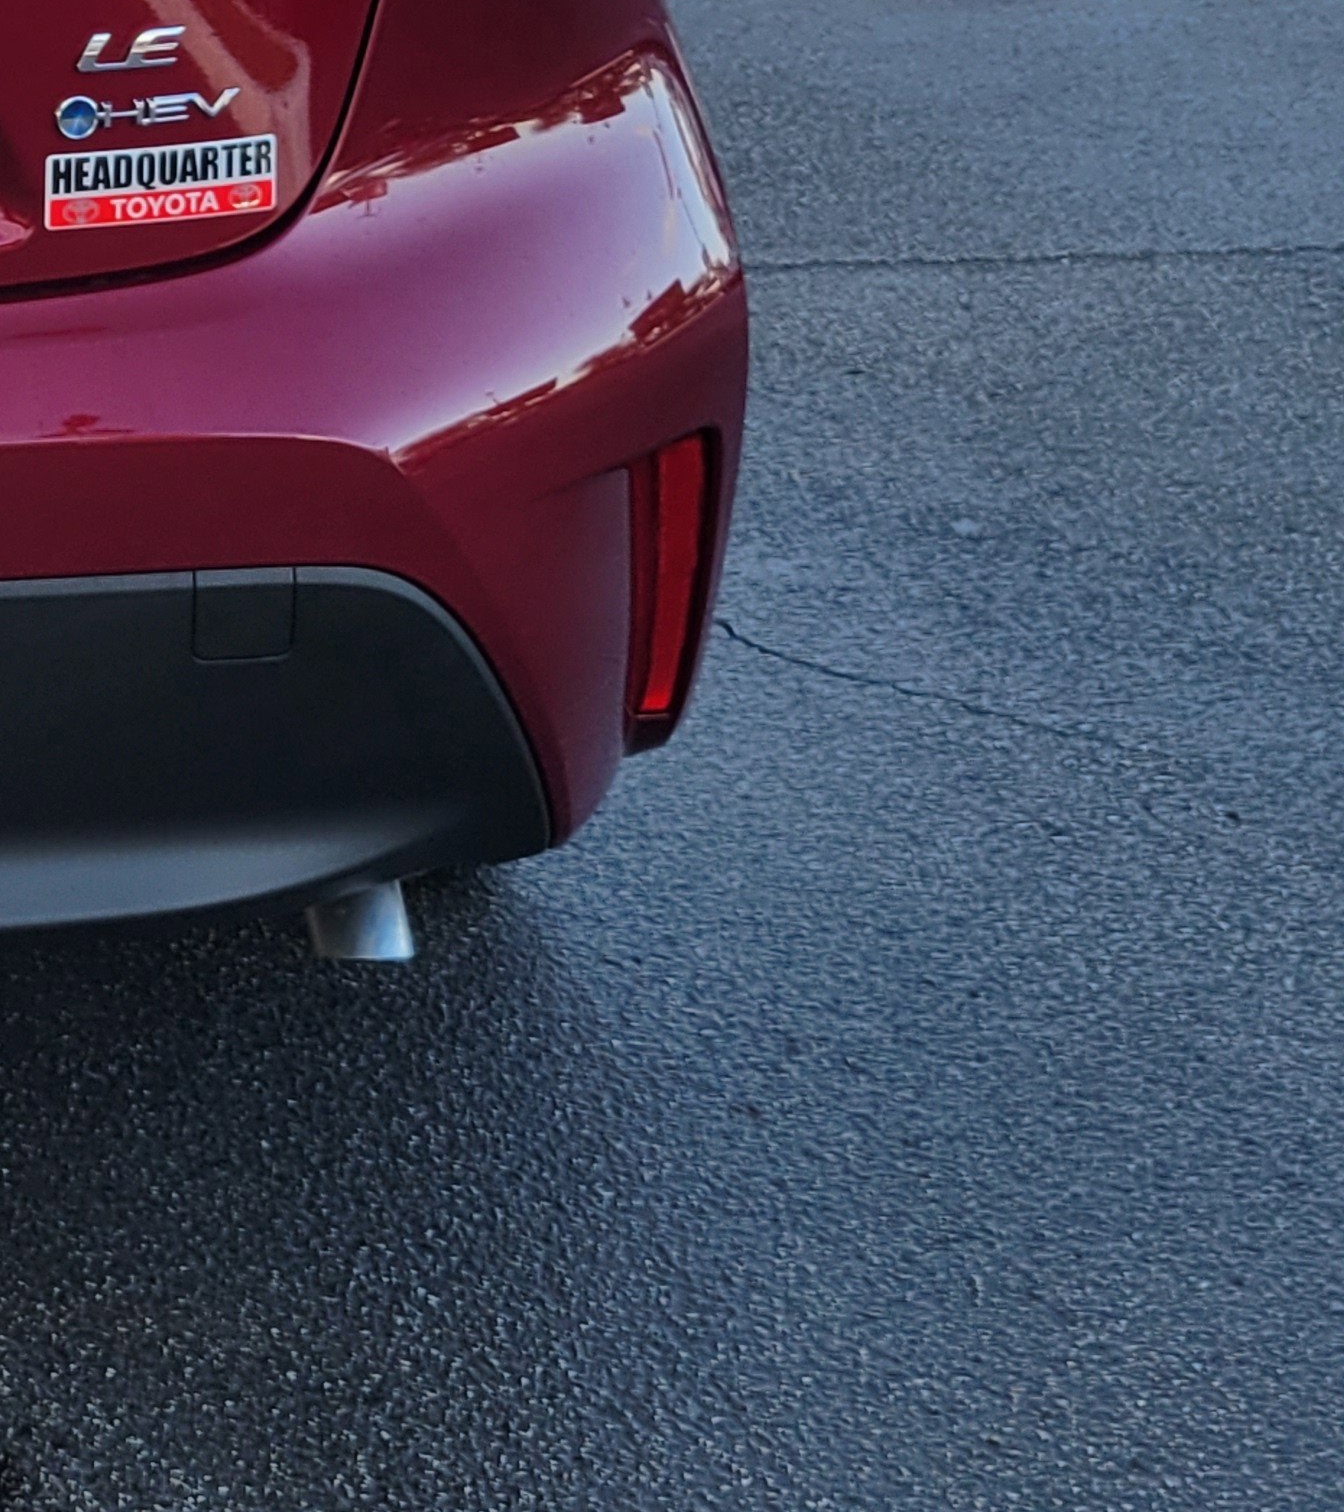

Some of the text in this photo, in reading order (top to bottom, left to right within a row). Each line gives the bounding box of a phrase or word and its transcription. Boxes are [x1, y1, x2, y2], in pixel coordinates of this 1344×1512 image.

[76, 25, 186, 73] LE
[51, 140, 272, 194] HEADQUARTER
[109, 190, 220, 221] TOYOTA
